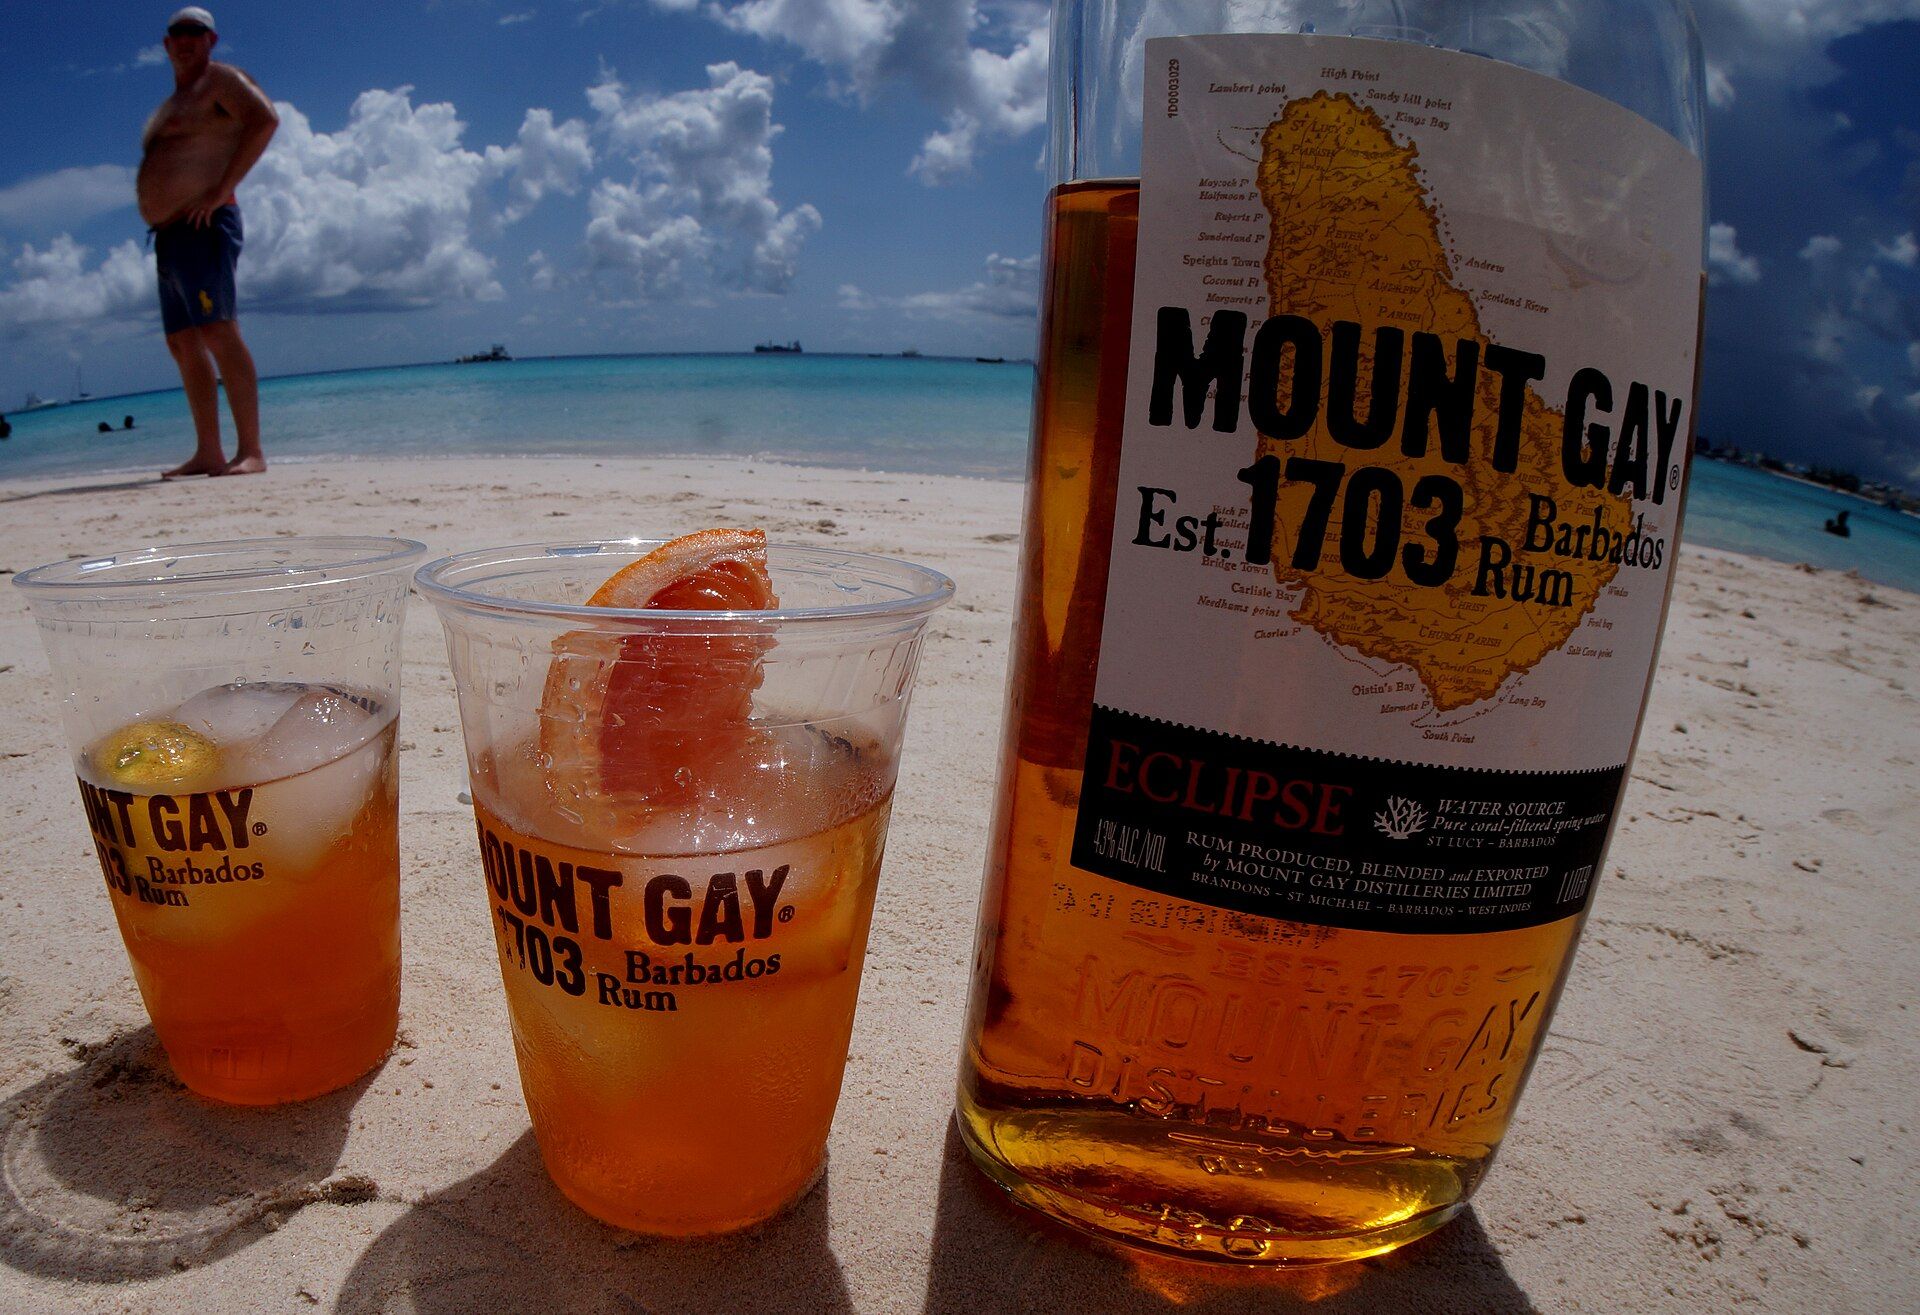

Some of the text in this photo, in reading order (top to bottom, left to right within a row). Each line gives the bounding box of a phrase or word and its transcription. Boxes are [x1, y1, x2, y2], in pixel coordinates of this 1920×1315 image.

[1320, 67, 1381, 82] High Point
[1257, 83, 1287, 95] point
[1366, 88, 1400, 104] Sandy
[1424, 97, 1452, 111] point
[1394, 111, 1451, 131] Kings Bay
[1182, 254, 1261, 268] Speights Town
[1465, 256, 1505, 273] Andrew
[1202, 274, 1245, 287] Coconut
[1480, 289, 1550, 314] Scotland River
[1149, 306, 1682, 506] MOUNT GAY
[1131, 454, 1464, 588] Est. 1703
[1521, 493, 1665, 570] Barbados
[1201, 556, 1269, 575] Bridge Town
[1471, 535, 1573, 608] Rum
[1231, 582, 1297, 603] Carlisle Bay
[1252, 606, 1281, 618] point
[1352, 681, 1416, 696] Oistin's Bay
[1508, 695, 1547, 709] Long Bay
[1422, 729, 1476, 744] South Point
[1103, 737, 1355, 836] ECLIPSE
[1437, 799, 1566, 816] WATER SOURCE
[148, 788, 253, 852] GAY
[1430, 816, 1467, 831] Pure
[1470, 816, 1550, 836] coral-filtered
[1552, 815, 1584, 833] spring
[1427, 836, 1556, 849] ST LUCY BARBADOS
[1185, 831, 1233, 854] RUM
[1360, 862, 1445, 882] BLENDED
[1449, 869, 1472, 883] and
[1475, 865, 1549, 883] EXPORTED
[146, 855, 265, 885] Barbados
[1202, 853, 1532, 899] by MOUNT GAY DISTILLERIES LIMITED
[134, 875, 190, 907] Rum
[1191, 871, 1532, 916] BRANDONS ST MICHAEL BARBADOS WEST INDIES
[644, 864, 790, 946] GAY
[624, 948, 781, 985] Barbados
[596, 972, 678, 1012] Rum
